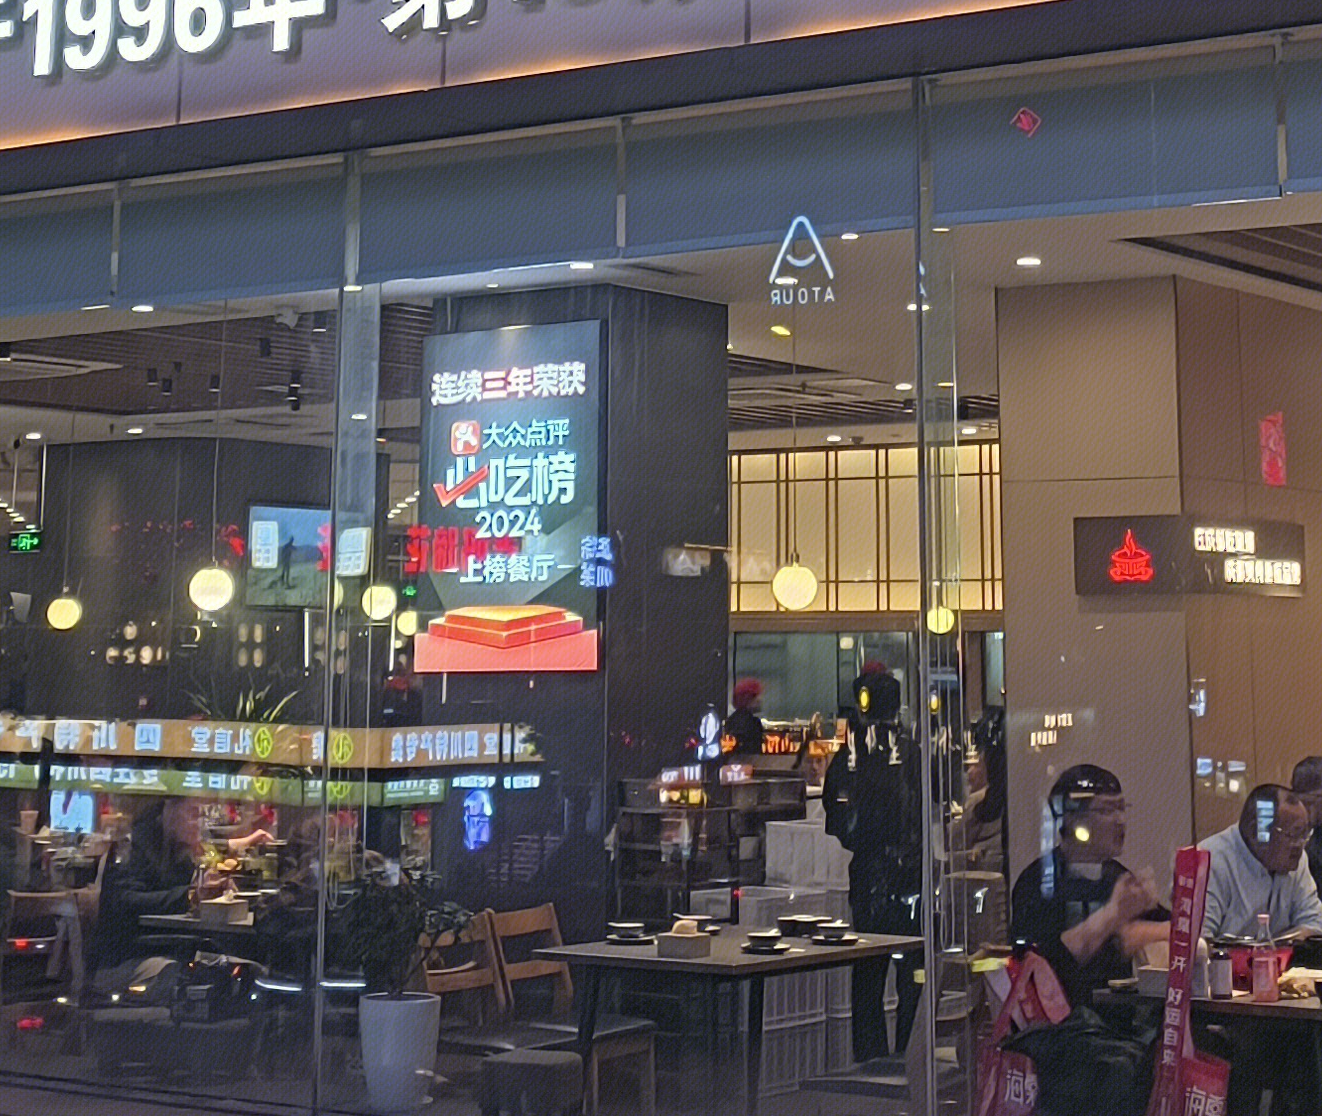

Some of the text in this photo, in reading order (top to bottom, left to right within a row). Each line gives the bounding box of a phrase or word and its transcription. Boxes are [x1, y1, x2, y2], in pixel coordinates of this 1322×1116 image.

[430, 361, 587, 406] 连续三年荣获
[482, 418, 570, 449] 大众点评
[434, 451, 576, 509] 必吃榜
[475, 510, 542, 539] 2024
[459, 553, 555, 583] 上榜餐厅
